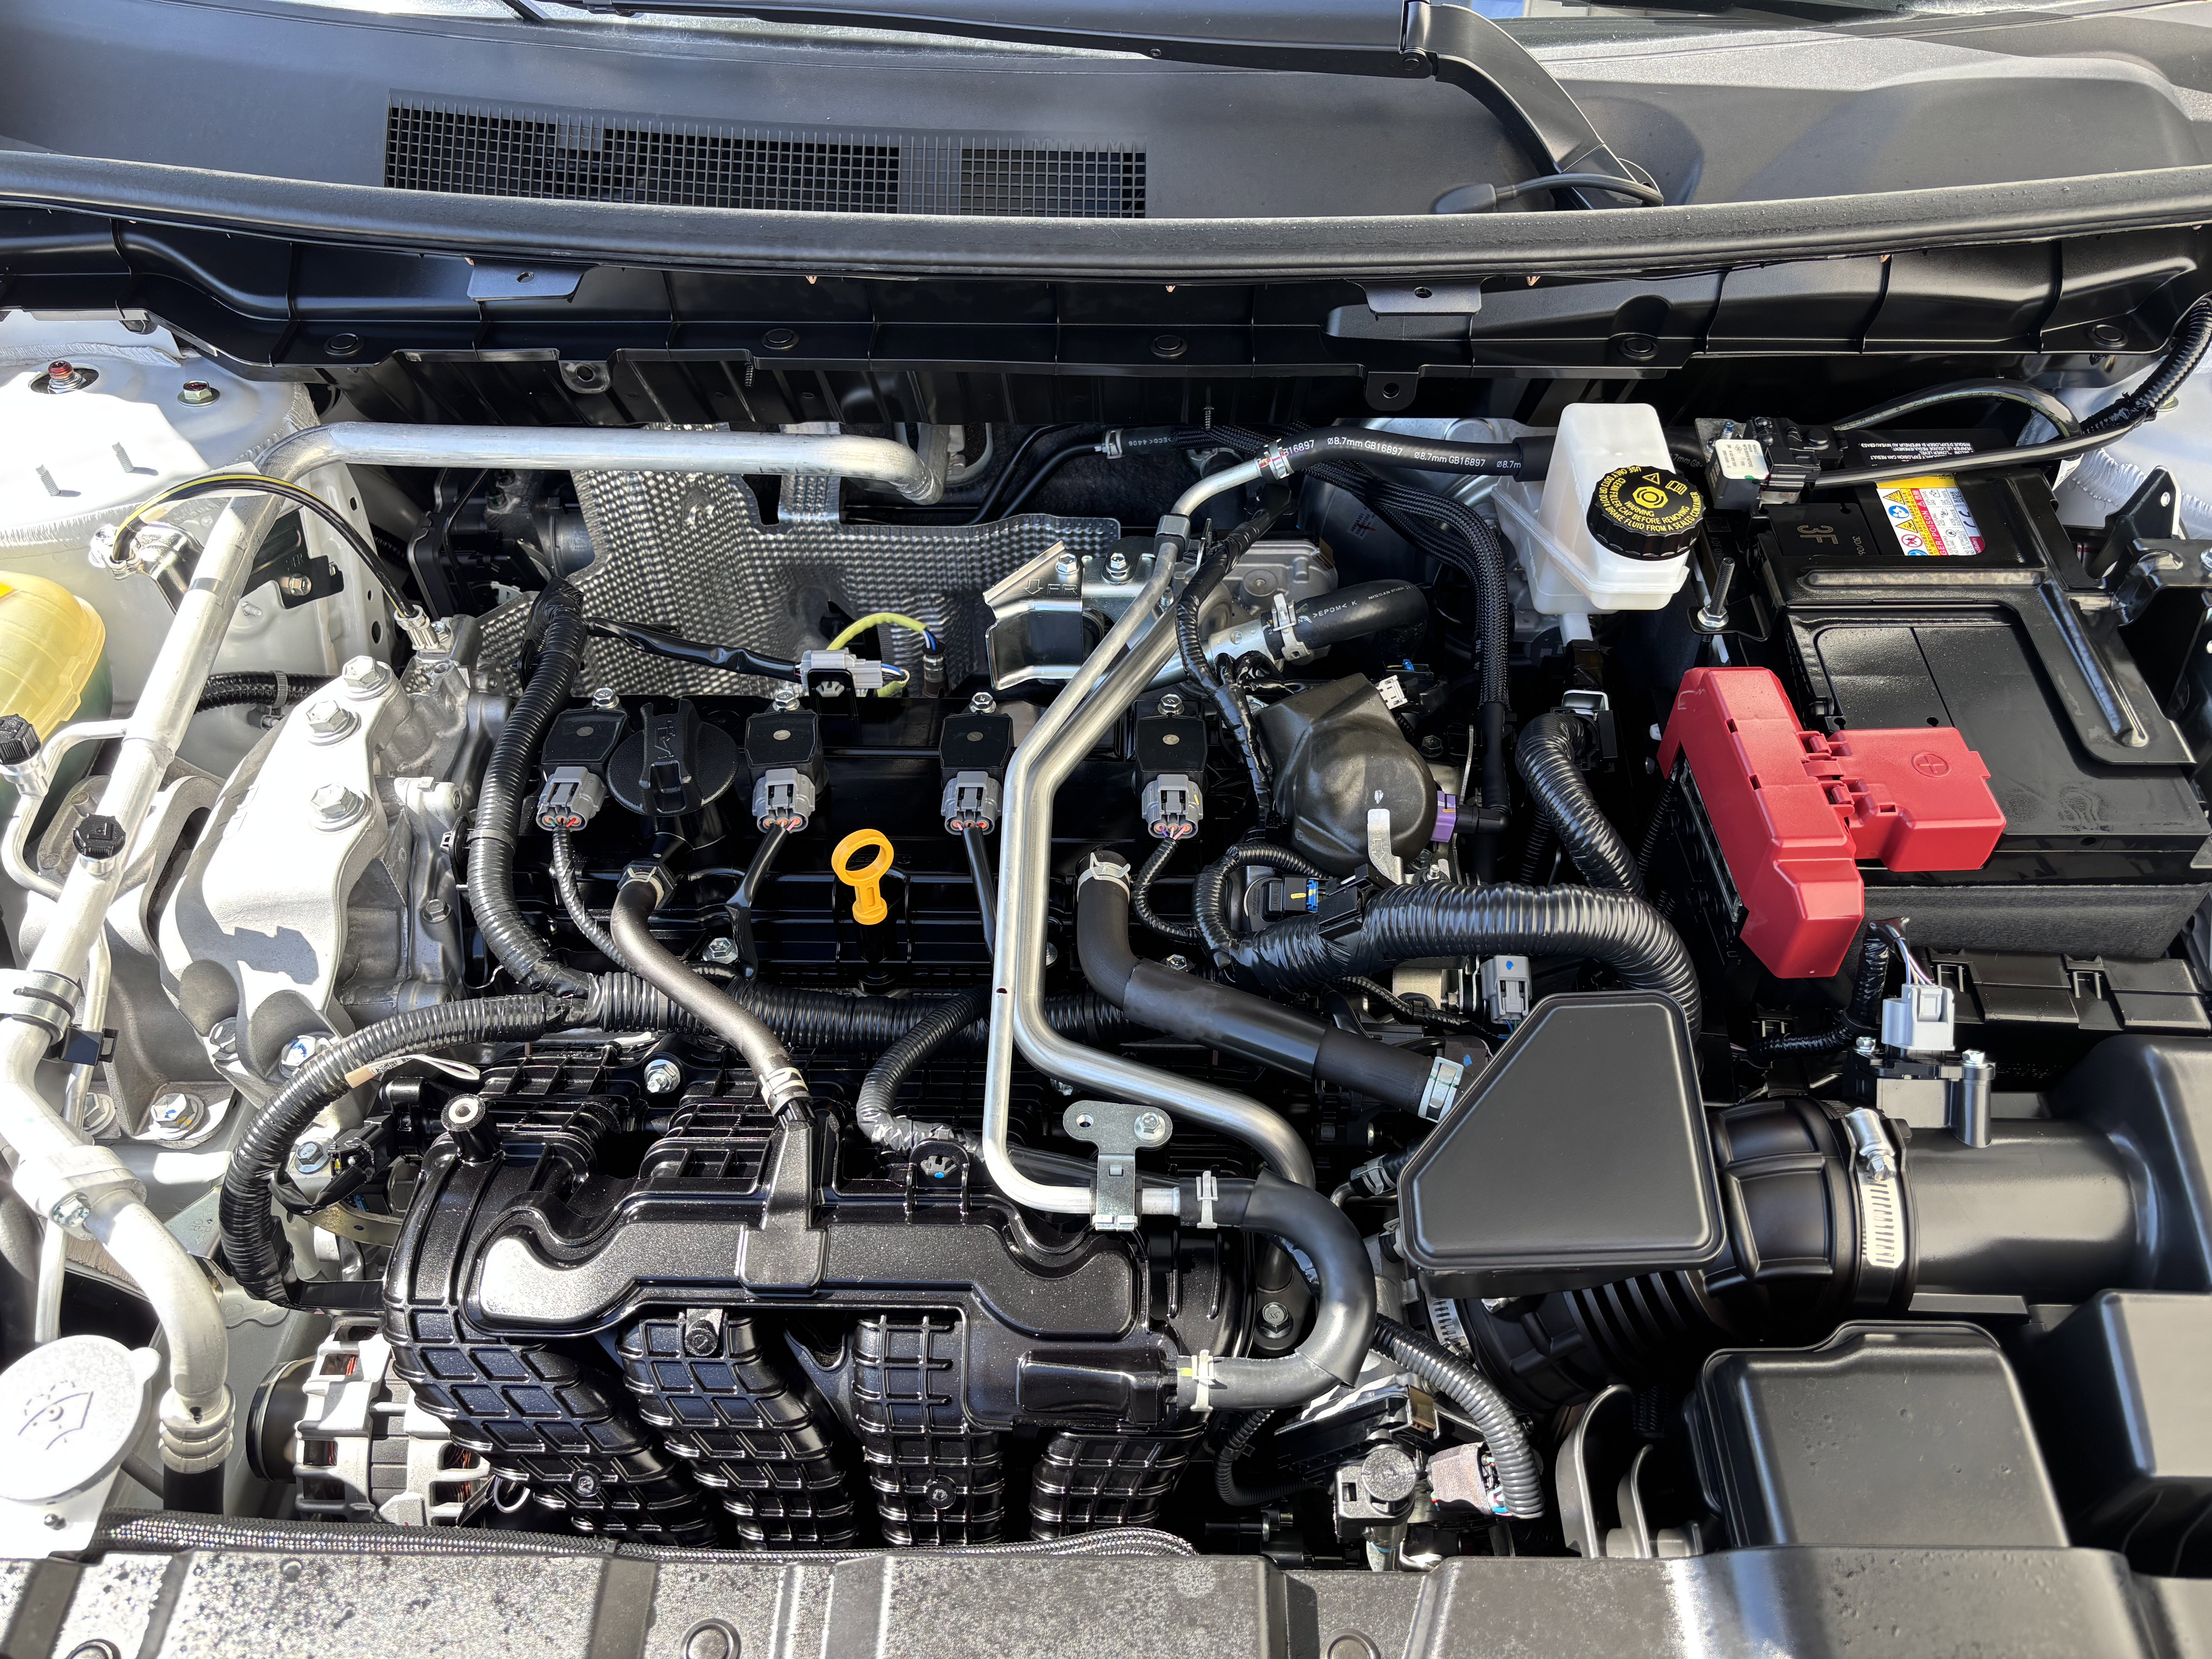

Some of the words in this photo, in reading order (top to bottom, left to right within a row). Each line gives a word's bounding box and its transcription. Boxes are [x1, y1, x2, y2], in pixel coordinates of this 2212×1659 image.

[1283, 440, 1315, 456] B16897
[1364, 441, 1403, 456] GB16897
[1448, 456, 1486, 467] GB16897
[1496, 460, 1522, 469] Ø8.7m
[1611, 469, 1627, 478] ONLY
[1601, 476, 1615, 487] DOT3
[1610, 477, 1626, 491] CLEAN
[1599, 495, 1611, 507] DOT4
[1609, 491, 1622, 508] FILLER
[1690, 492, 1701, 517] CONTAINER
[1605, 507, 1625, 522] BRAKE
[1618, 507, 1633, 516] CAP
[1624, 500, 1654, 517] WARNING
[1661, 506, 1690, 524] REMOVING
[1624, 518, 1644, 529] FLUID
[1632, 514, 1661, 524] BEFORE
[1673, 516, 1695, 530] SEALED
[1047, 584, 1078, 595] FR
[1313, 603, 1347, 618] >EPDM<
[1368, 590, 1390, 600] NISSAN
